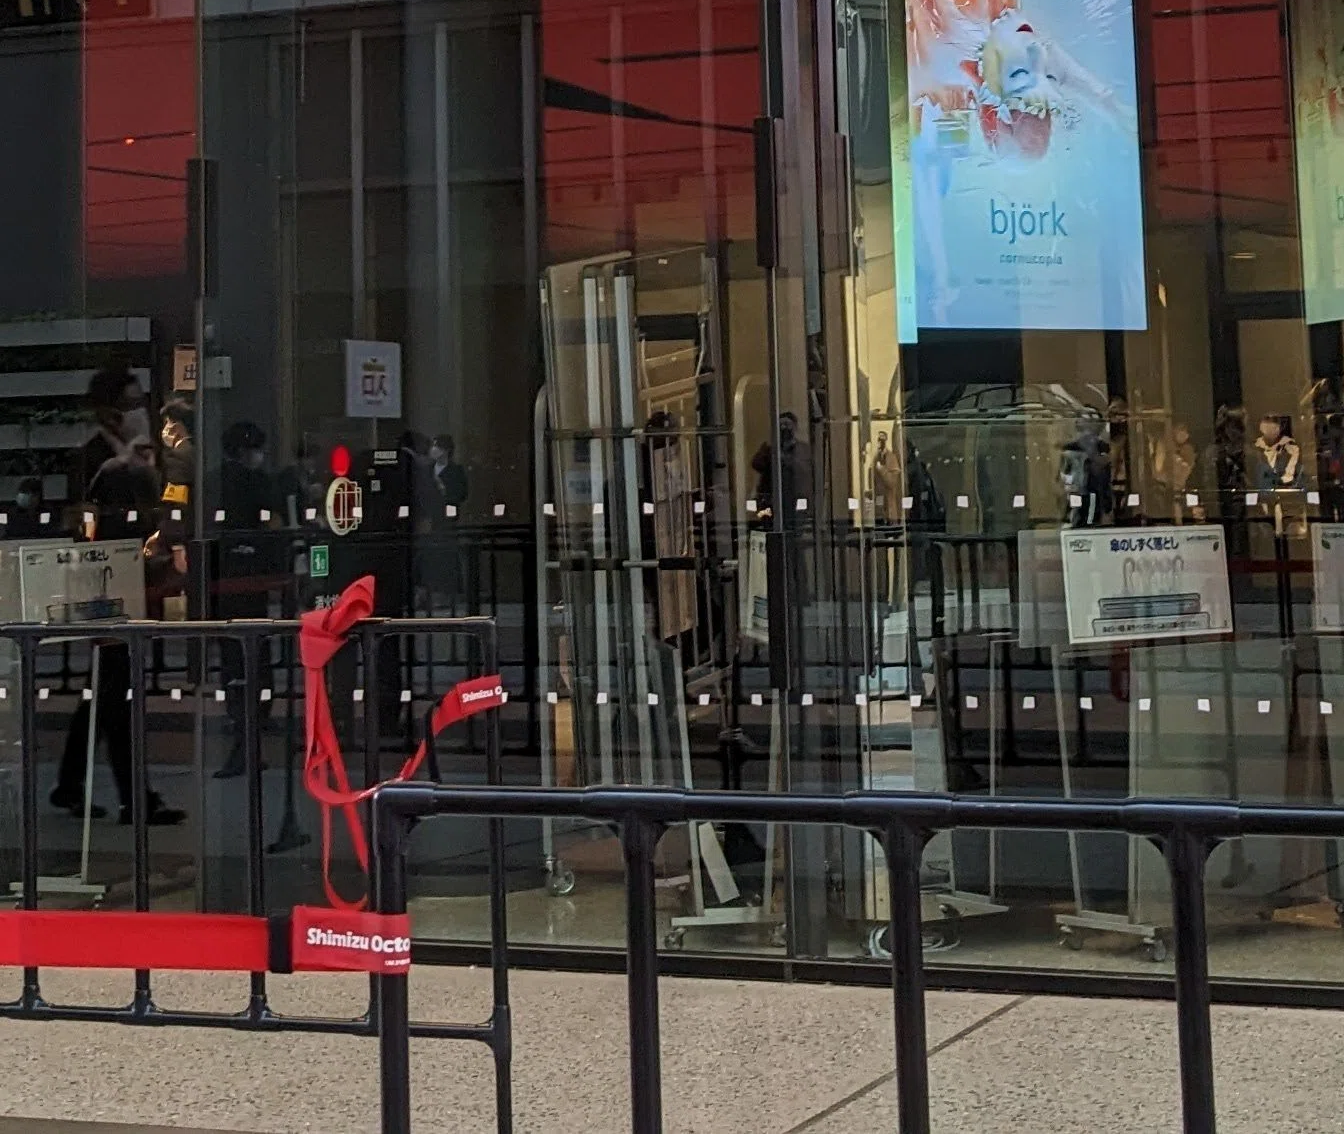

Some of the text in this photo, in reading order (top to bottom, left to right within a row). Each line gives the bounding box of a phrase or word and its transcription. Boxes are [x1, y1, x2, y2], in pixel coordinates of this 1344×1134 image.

[990, 198, 1068, 244] björk
[1000, 253, 1063, 266] cornucopia
[1109, 537, 1180, 552] 傘のしずく落とし
[307, 927, 411, 953] Shimizu Octo
